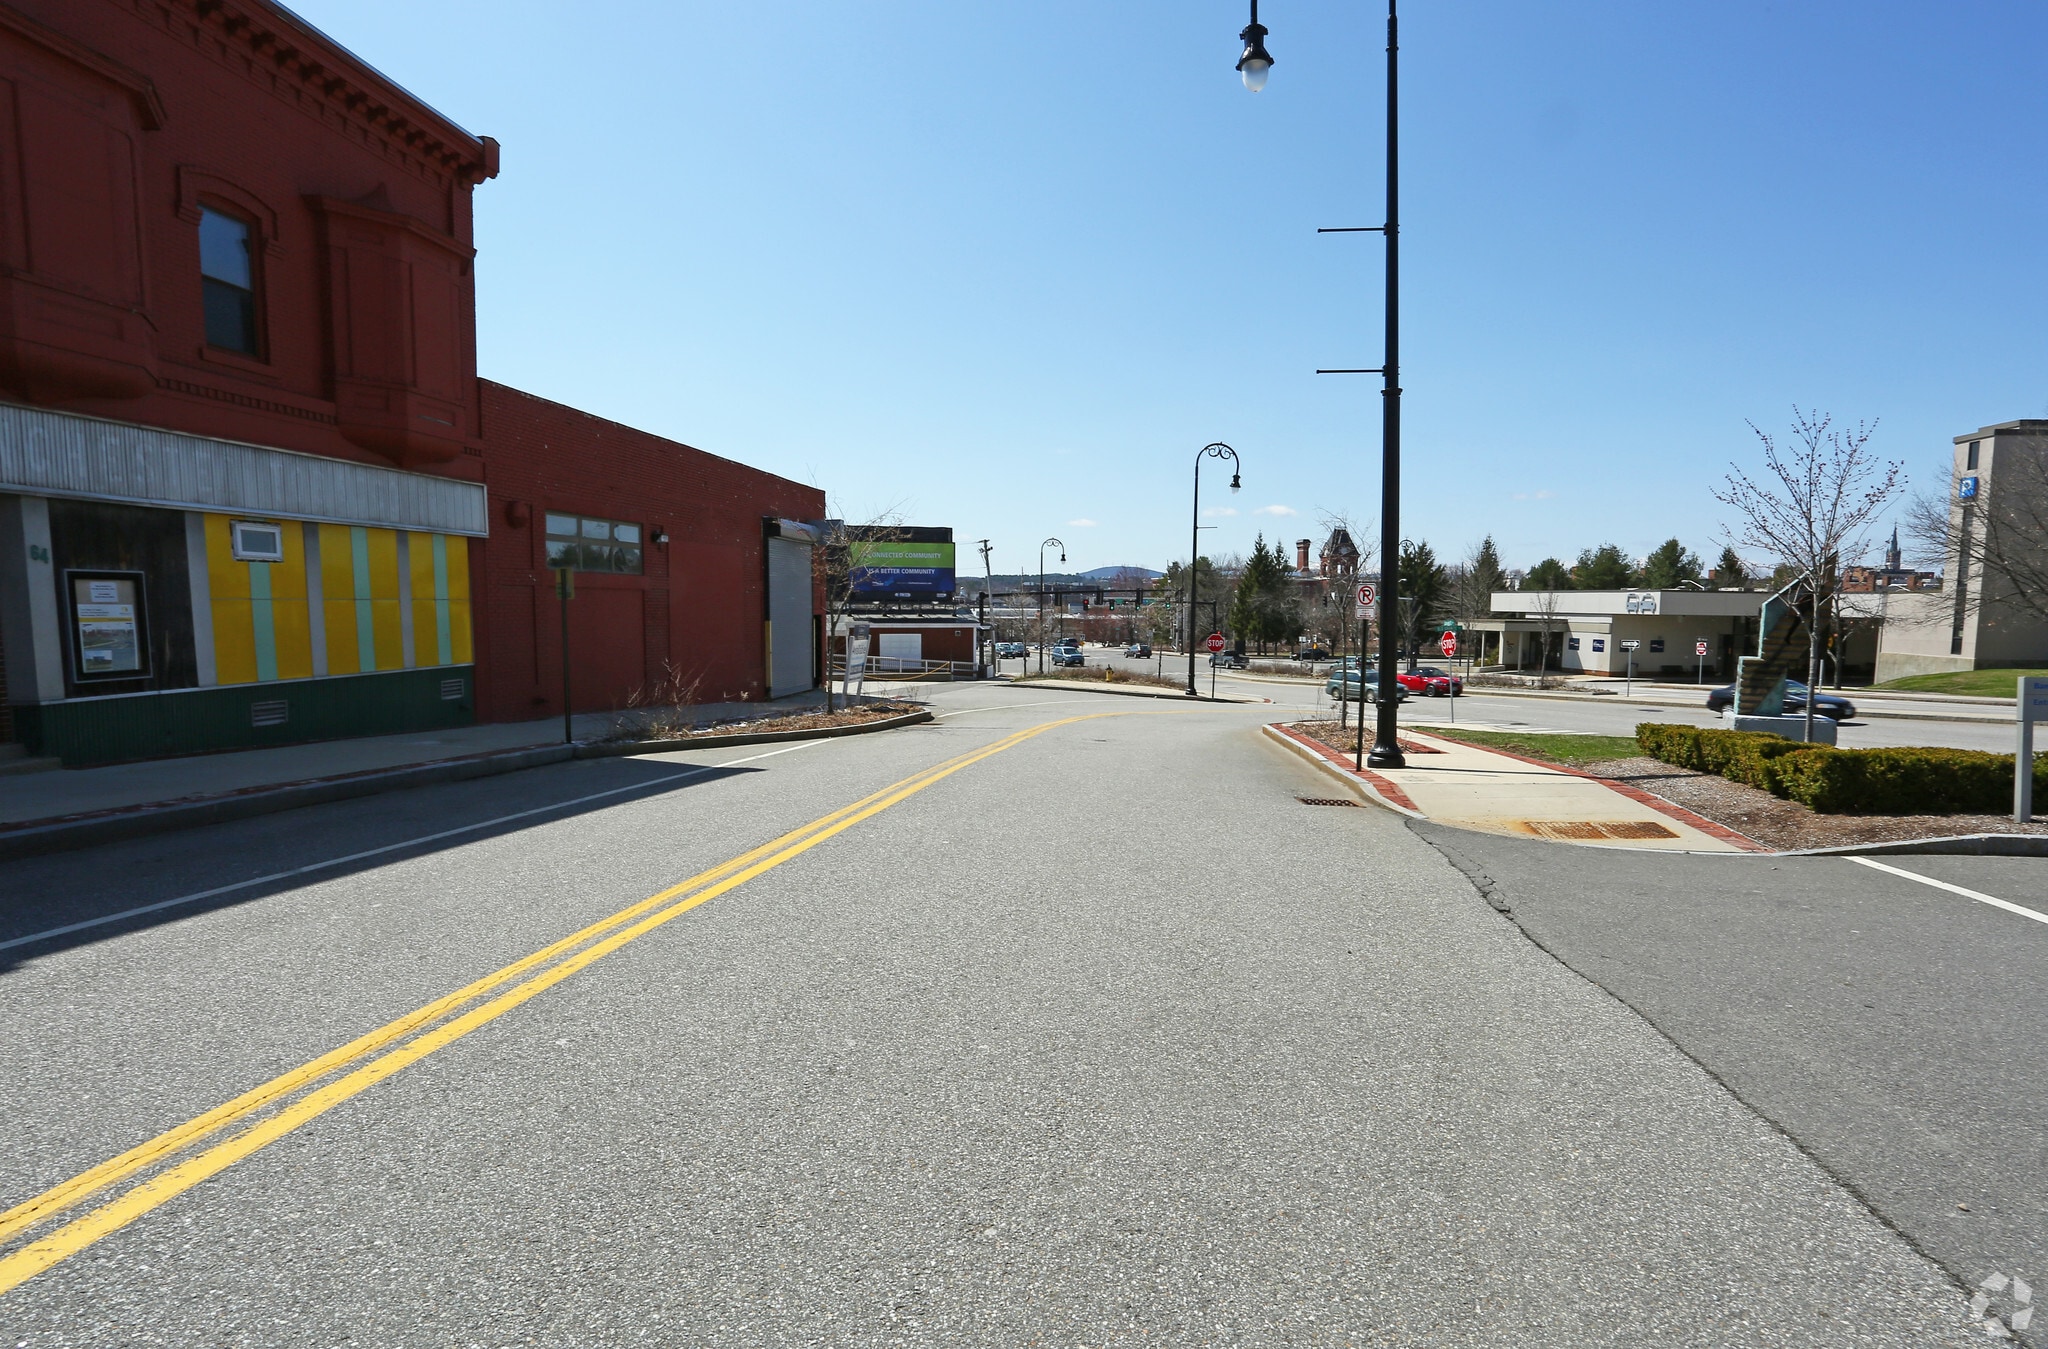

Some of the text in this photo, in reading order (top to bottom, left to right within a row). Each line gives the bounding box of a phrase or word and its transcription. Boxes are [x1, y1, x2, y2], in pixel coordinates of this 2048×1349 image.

[30, 544, 49, 564] 64
[1207, 639, 1224, 647] STOP
[1442, 638, 1456, 650] STOP
